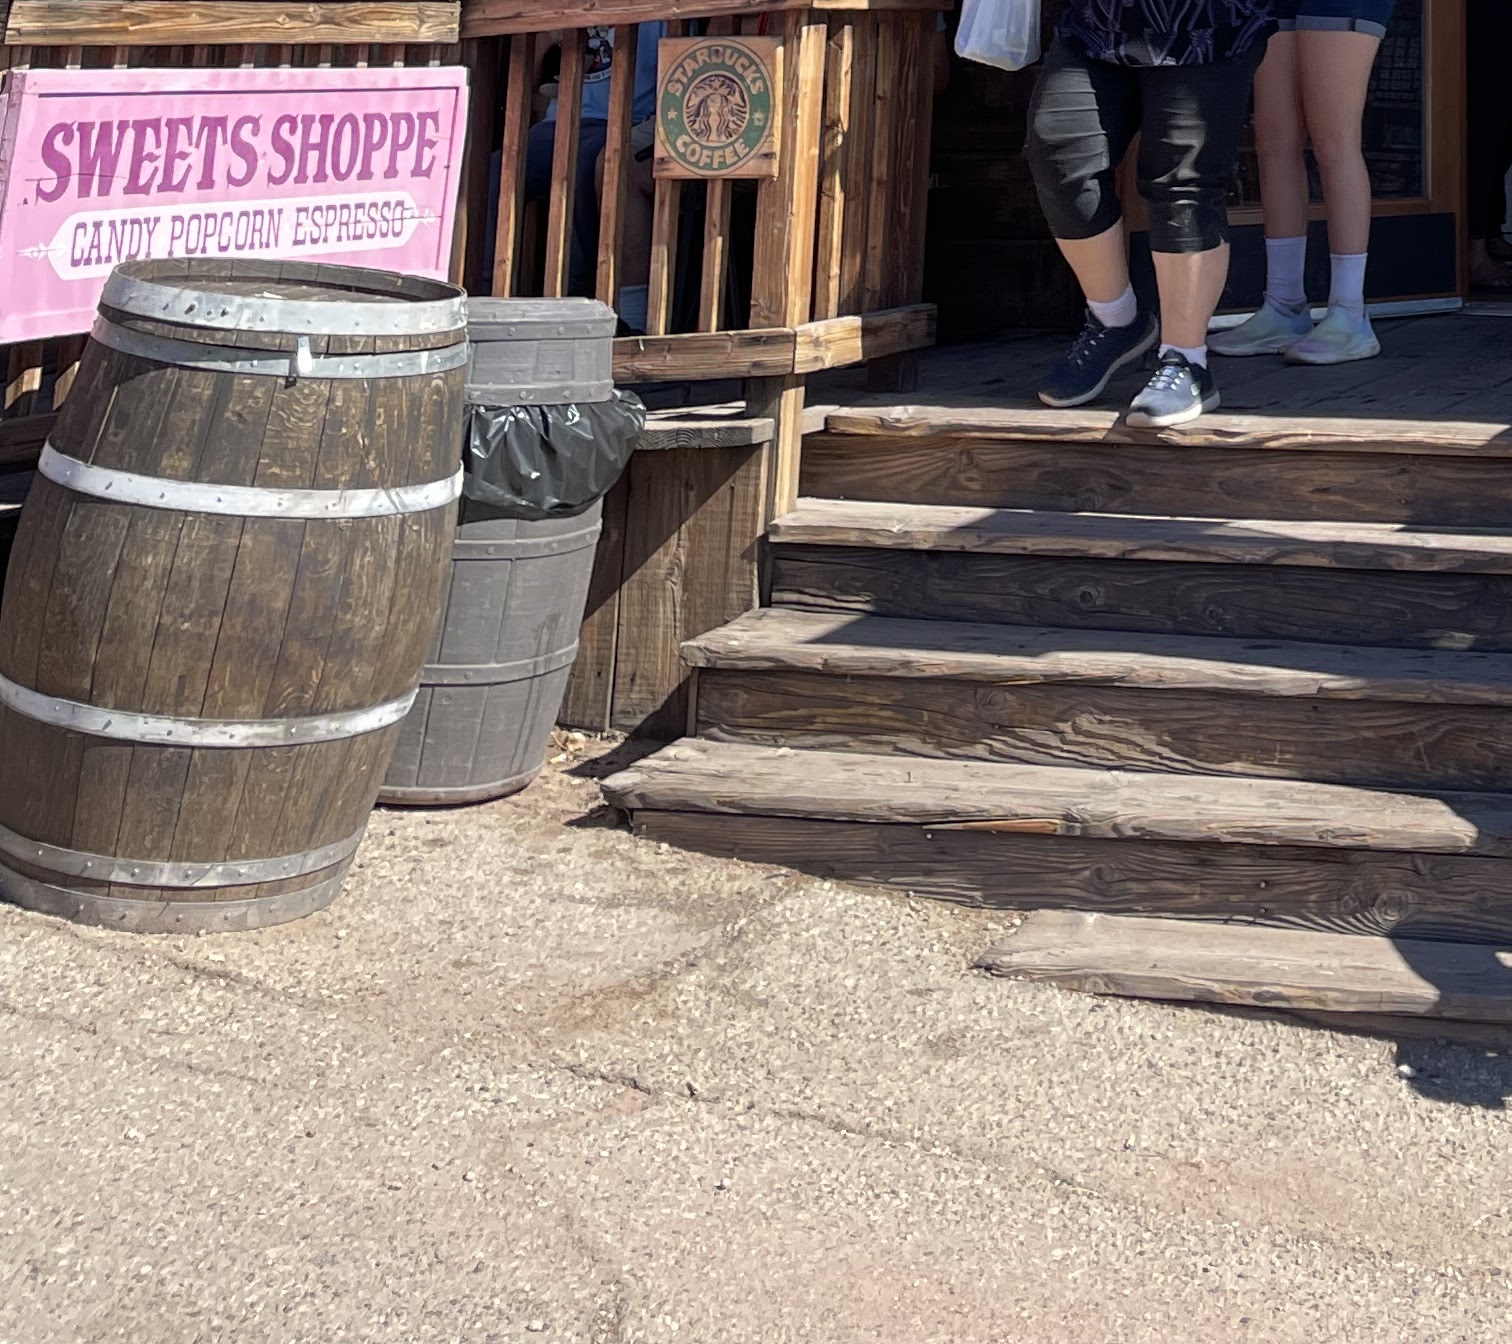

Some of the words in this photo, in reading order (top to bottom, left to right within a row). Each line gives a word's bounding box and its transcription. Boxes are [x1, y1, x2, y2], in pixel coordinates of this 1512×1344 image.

[667, 46, 764, 97] STARBUCKS
[36, 113, 261, 204] SWEETS
[267, 109, 440, 188] SHOPPE
[676, 134, 749, 168] COFFEE
[70, 215, 160, 267] CANDY
[168, 207, 286, 258] POPCORN
[292, 200, 405, 245] ESPRESSO
